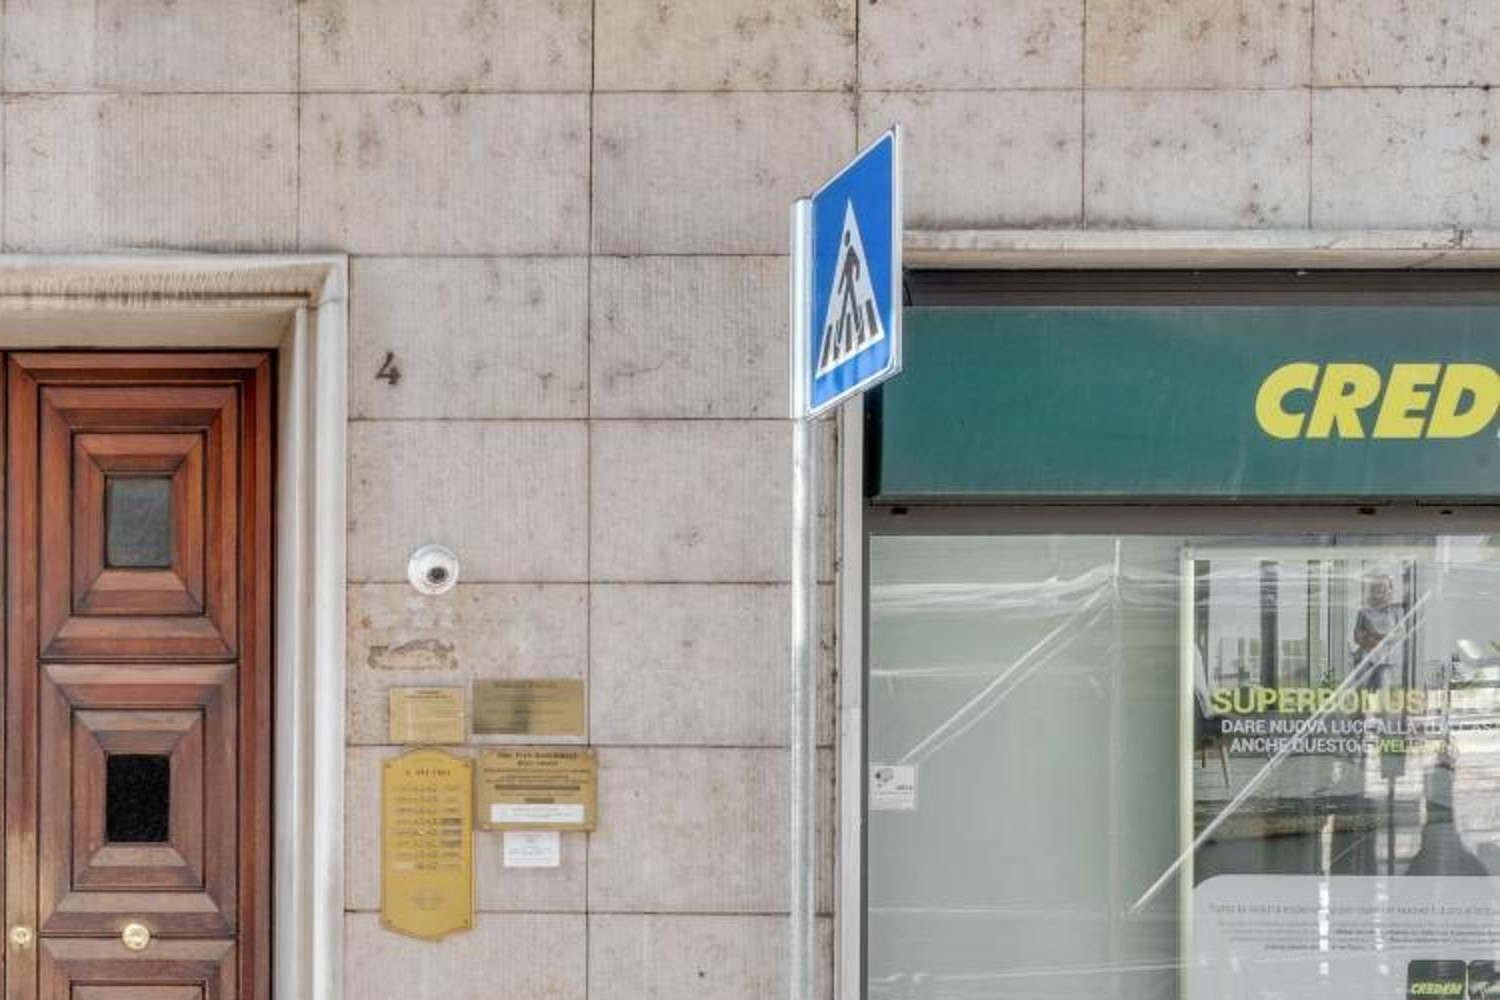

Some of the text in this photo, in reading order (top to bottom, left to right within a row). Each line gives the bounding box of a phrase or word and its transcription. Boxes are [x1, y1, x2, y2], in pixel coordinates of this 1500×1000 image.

[375, 350, 402, 385] 4
[1221, 719, 1266, 734] DARE
[1269, 719, 1328, 734] NUOVA
[1291, 737, 1358, 753] QUESTO
